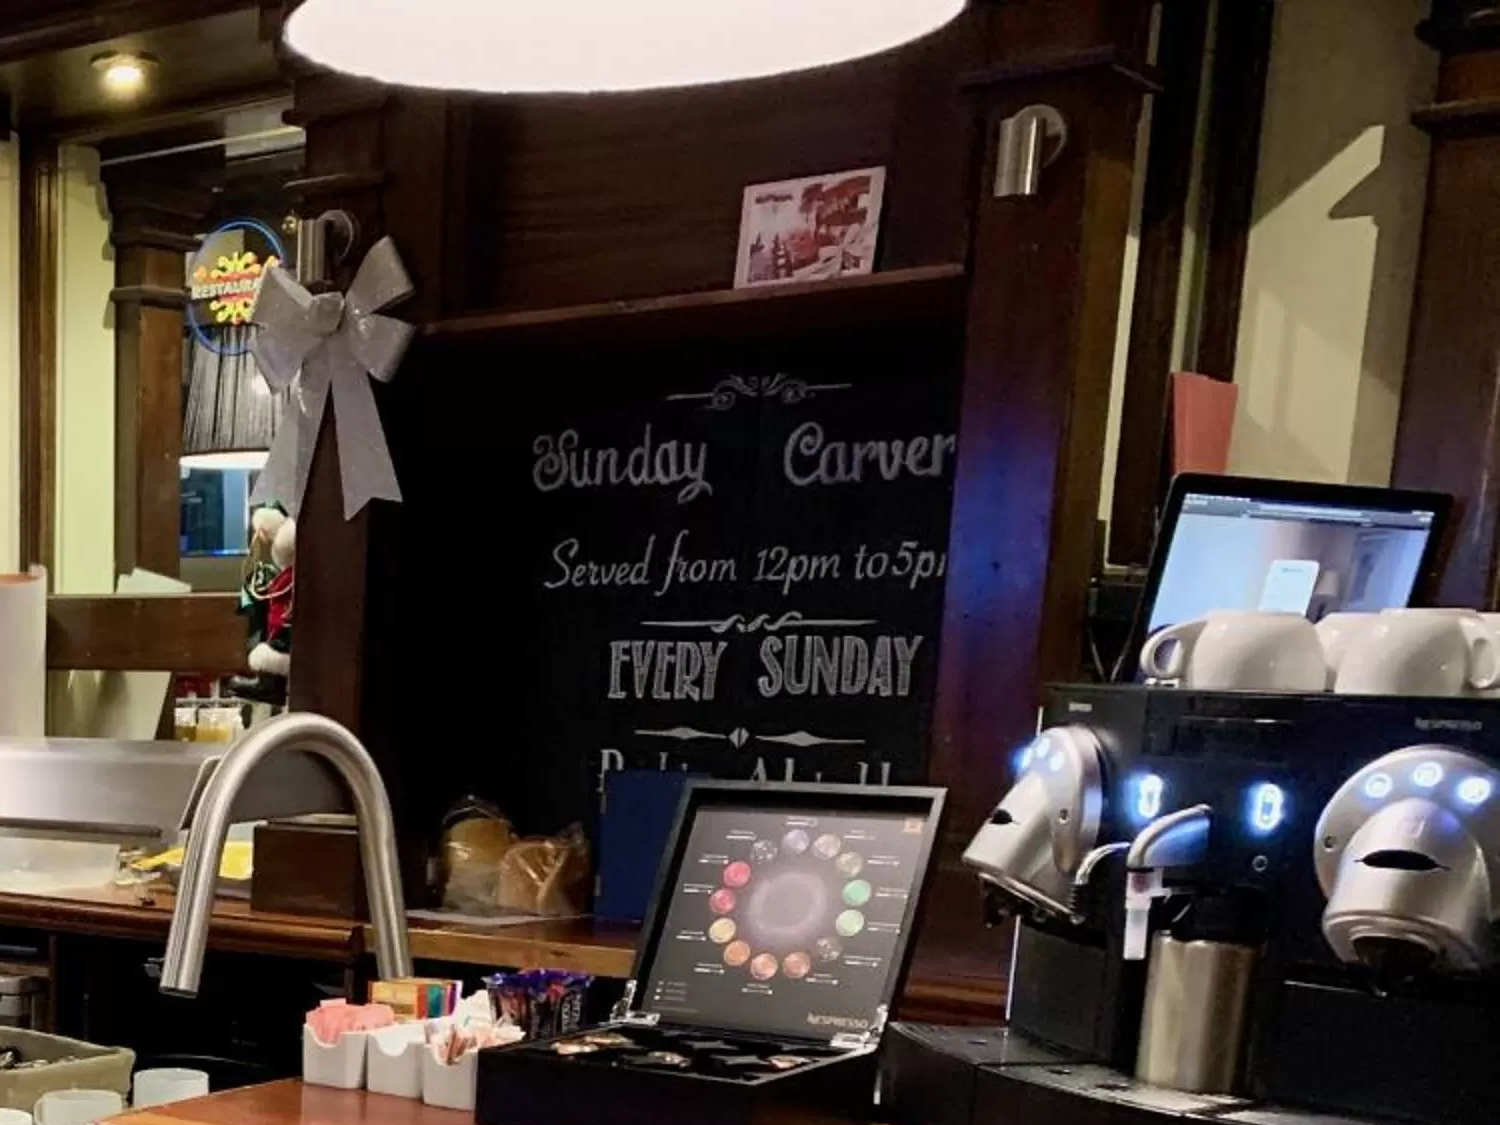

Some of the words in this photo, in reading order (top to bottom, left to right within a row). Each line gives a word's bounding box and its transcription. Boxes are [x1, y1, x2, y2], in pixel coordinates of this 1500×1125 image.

[532, 422, 713, 505] Sunday
[543, 532, 656, 589] Served
[653, 528, 737, 597] from
[752, 545, 841, 596] 12pm
[607, 640, 728, 701] EVERY
[757, 635, 925, 697] SUNDAY
